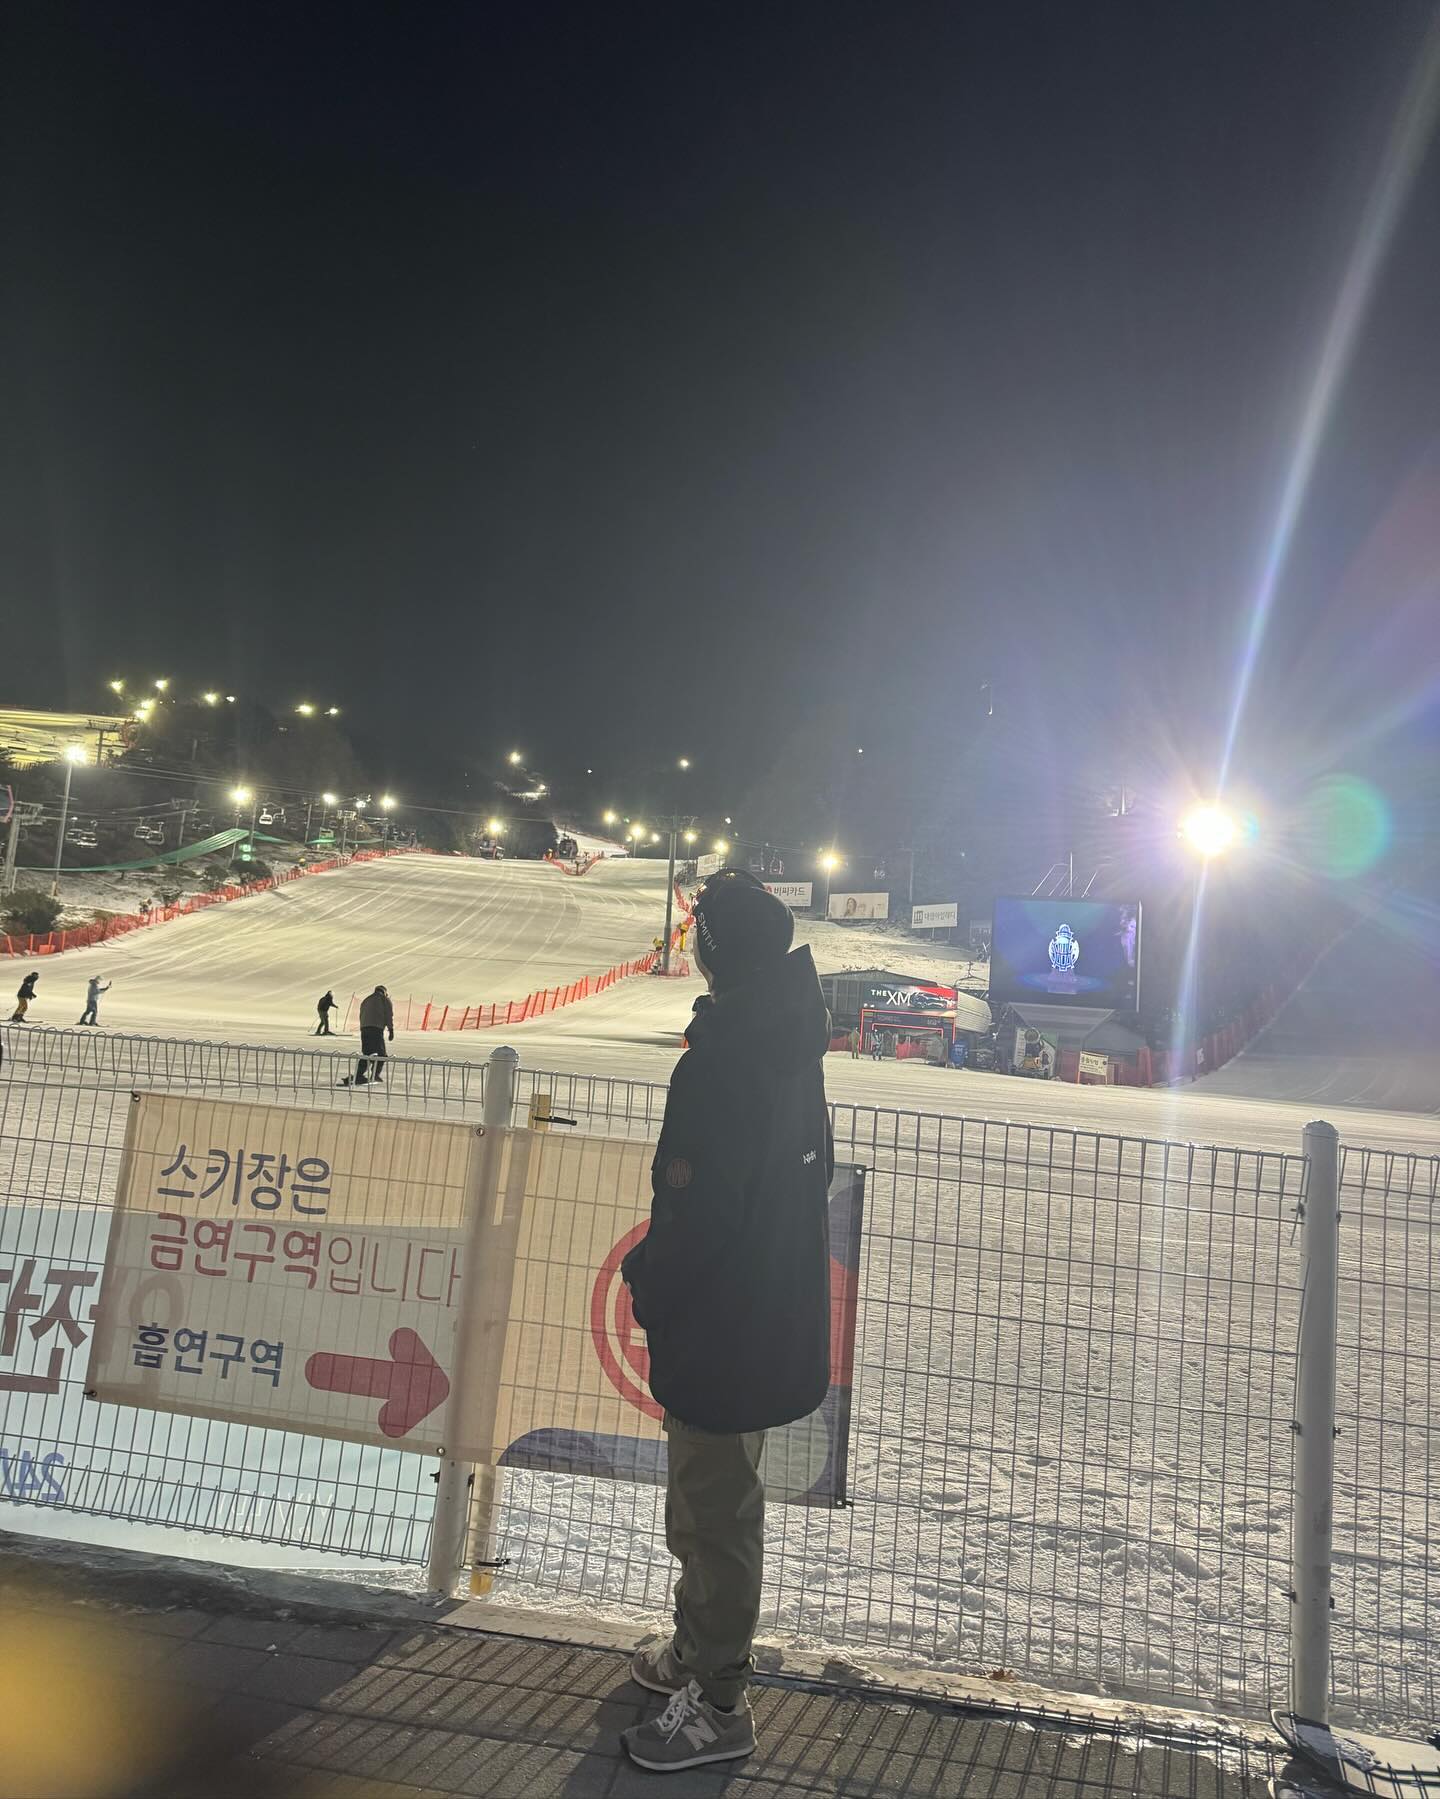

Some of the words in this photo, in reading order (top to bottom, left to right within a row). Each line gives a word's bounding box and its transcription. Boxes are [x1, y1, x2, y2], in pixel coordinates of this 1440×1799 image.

[698, 912, 717, 952] SMITH
[157, 1144, 331, 1215] 스키장은
[150, 1212, 462, 1307] 금연구역입니다
[132, 1321, 285, 1388] 흡연구역
